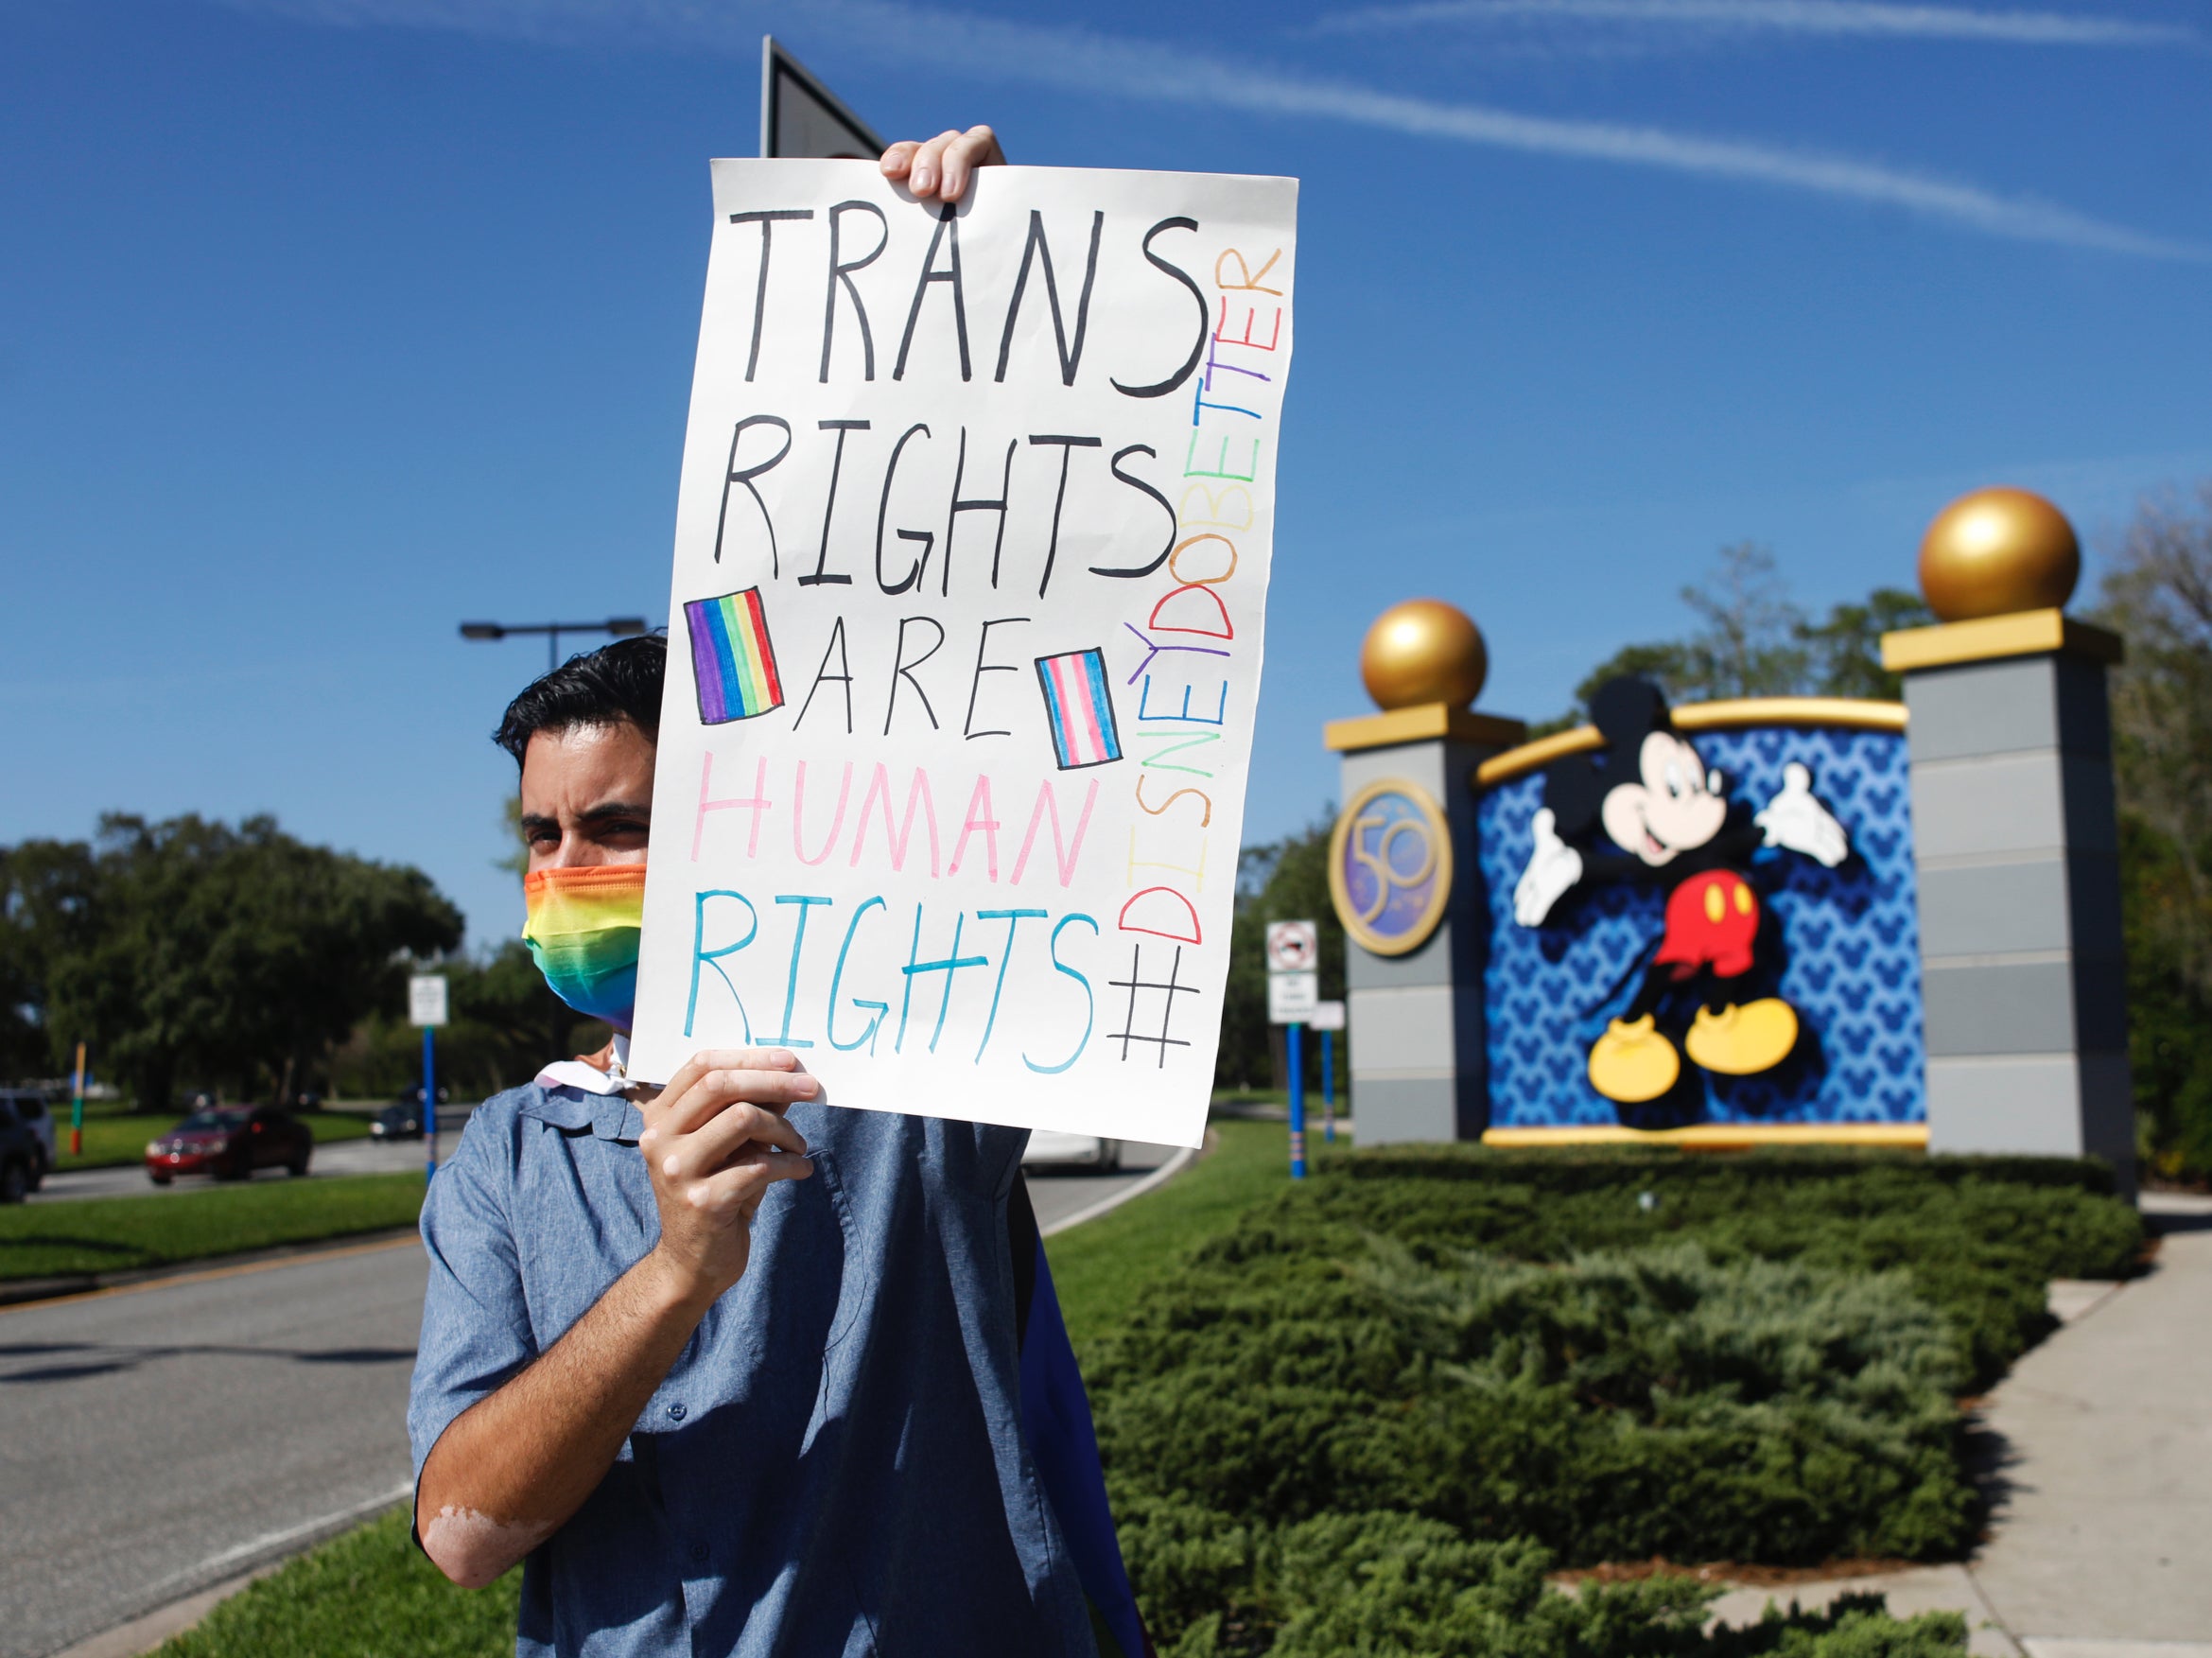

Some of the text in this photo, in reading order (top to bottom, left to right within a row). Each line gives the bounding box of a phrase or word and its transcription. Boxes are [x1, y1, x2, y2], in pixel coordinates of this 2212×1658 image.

[730, 200, 1209, 397] TRANS
[714, 414, 1177, 600] RIGHTS
[792, 616, 1031, 741] ARE
[689, 751, 1100, 888] HUMAN
[1353, 816, 1439, 926] 50
[684, 889, 1099, 1074] RIGHTS
